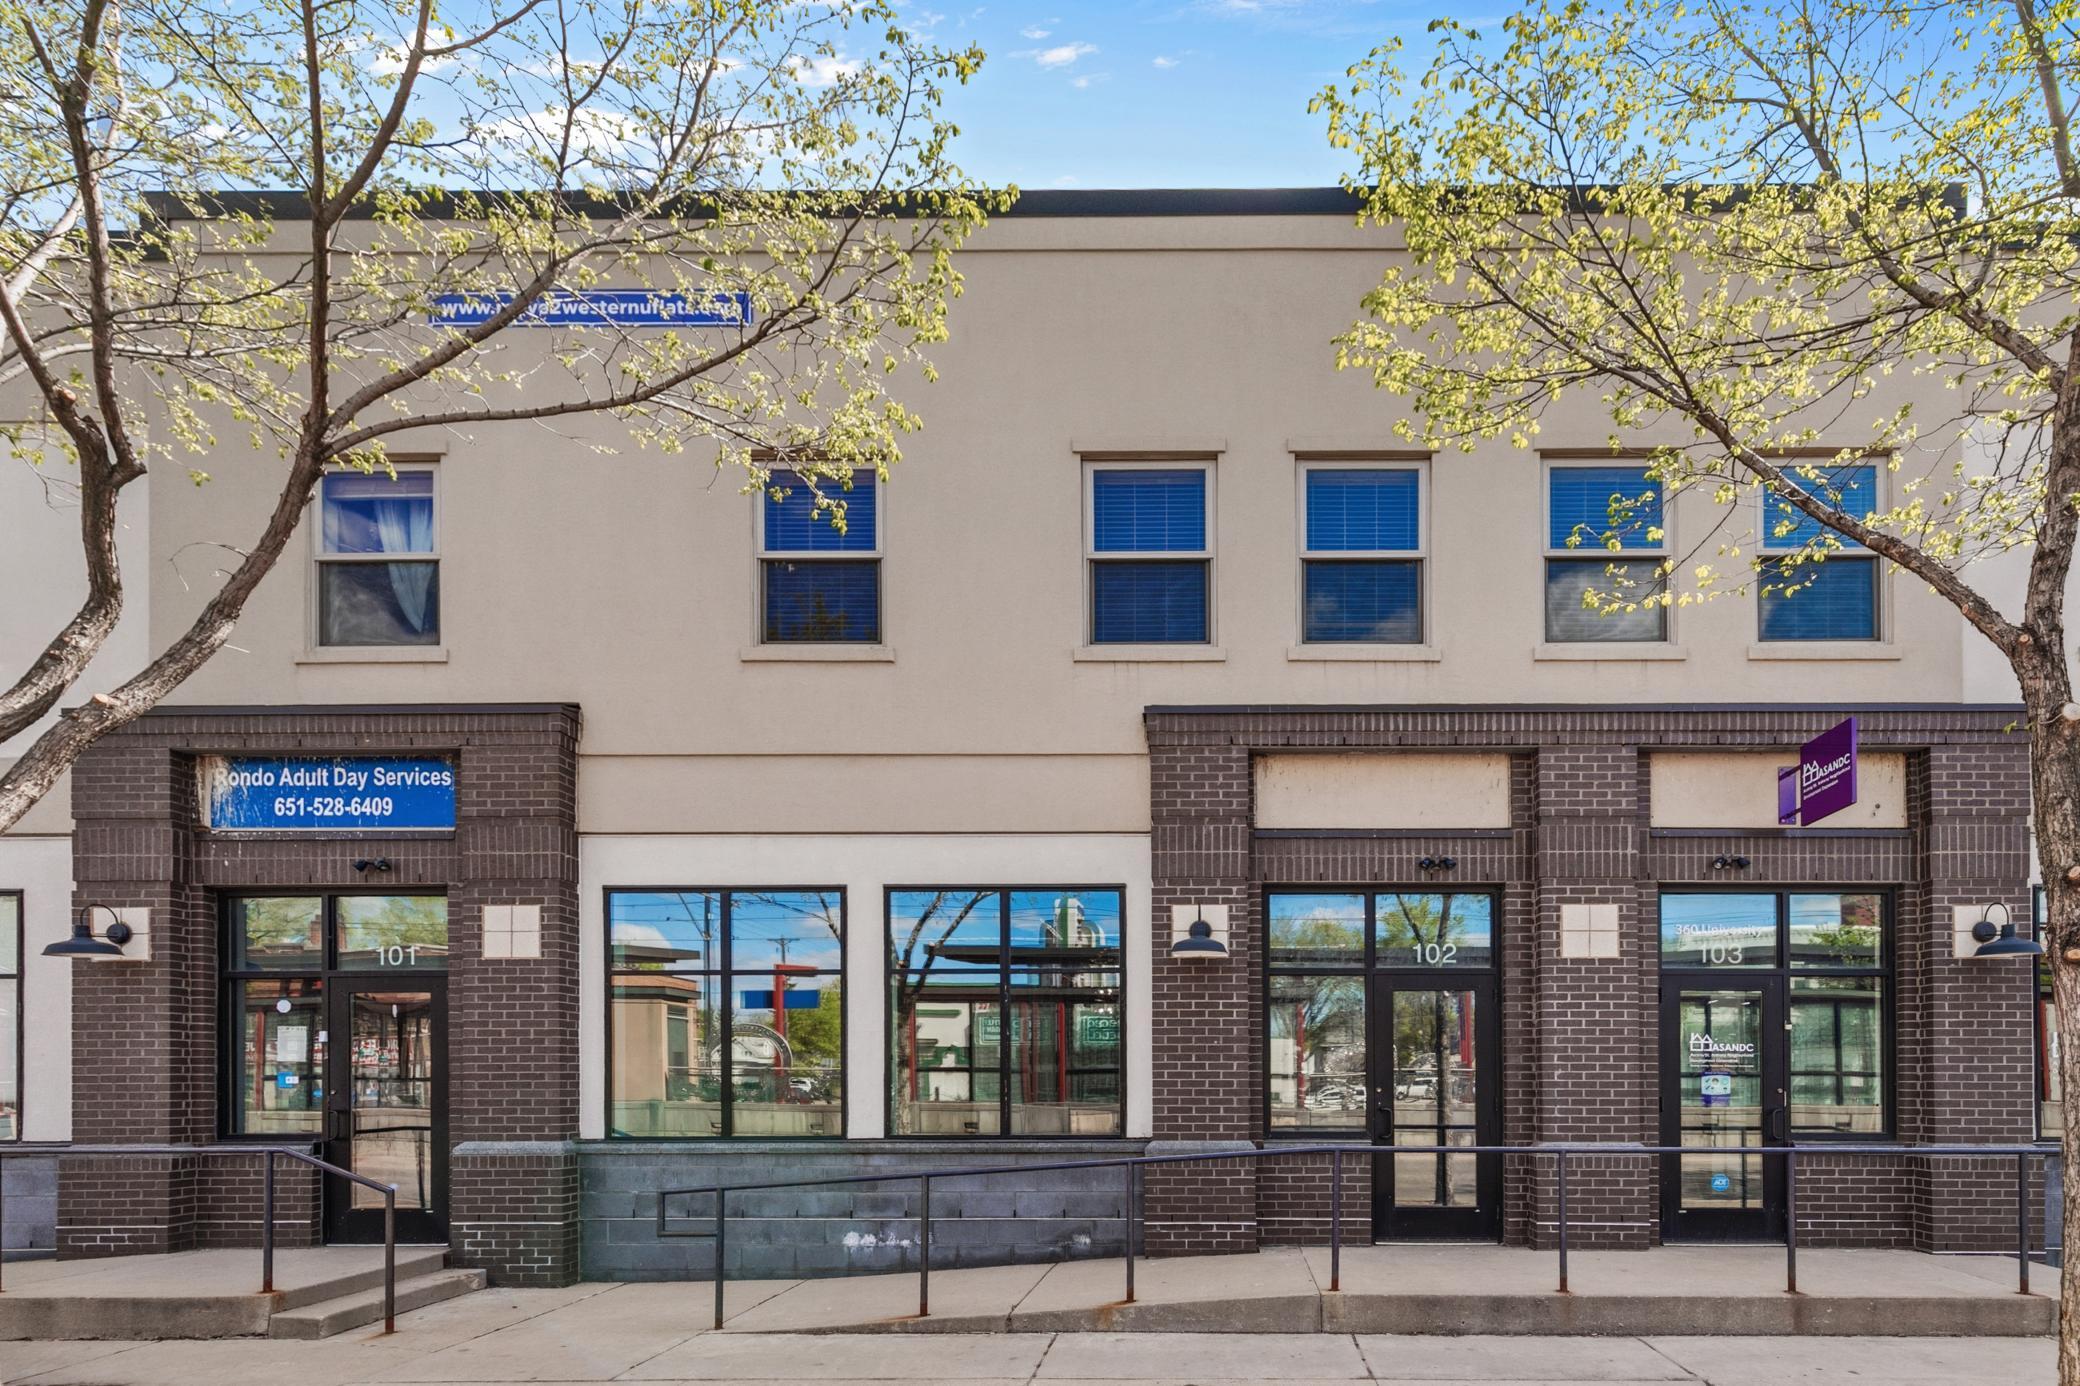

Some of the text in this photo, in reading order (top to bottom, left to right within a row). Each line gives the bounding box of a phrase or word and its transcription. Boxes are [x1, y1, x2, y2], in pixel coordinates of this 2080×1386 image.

[213, 766, 452, 791] Rondo Adult Day Services
[274, 797, 393, 817] 651-528-6409
[375, 945, 416, 966] 101
[1412, 943, 1457, 964] 102
[1701, 943, 1743, 964] 103
